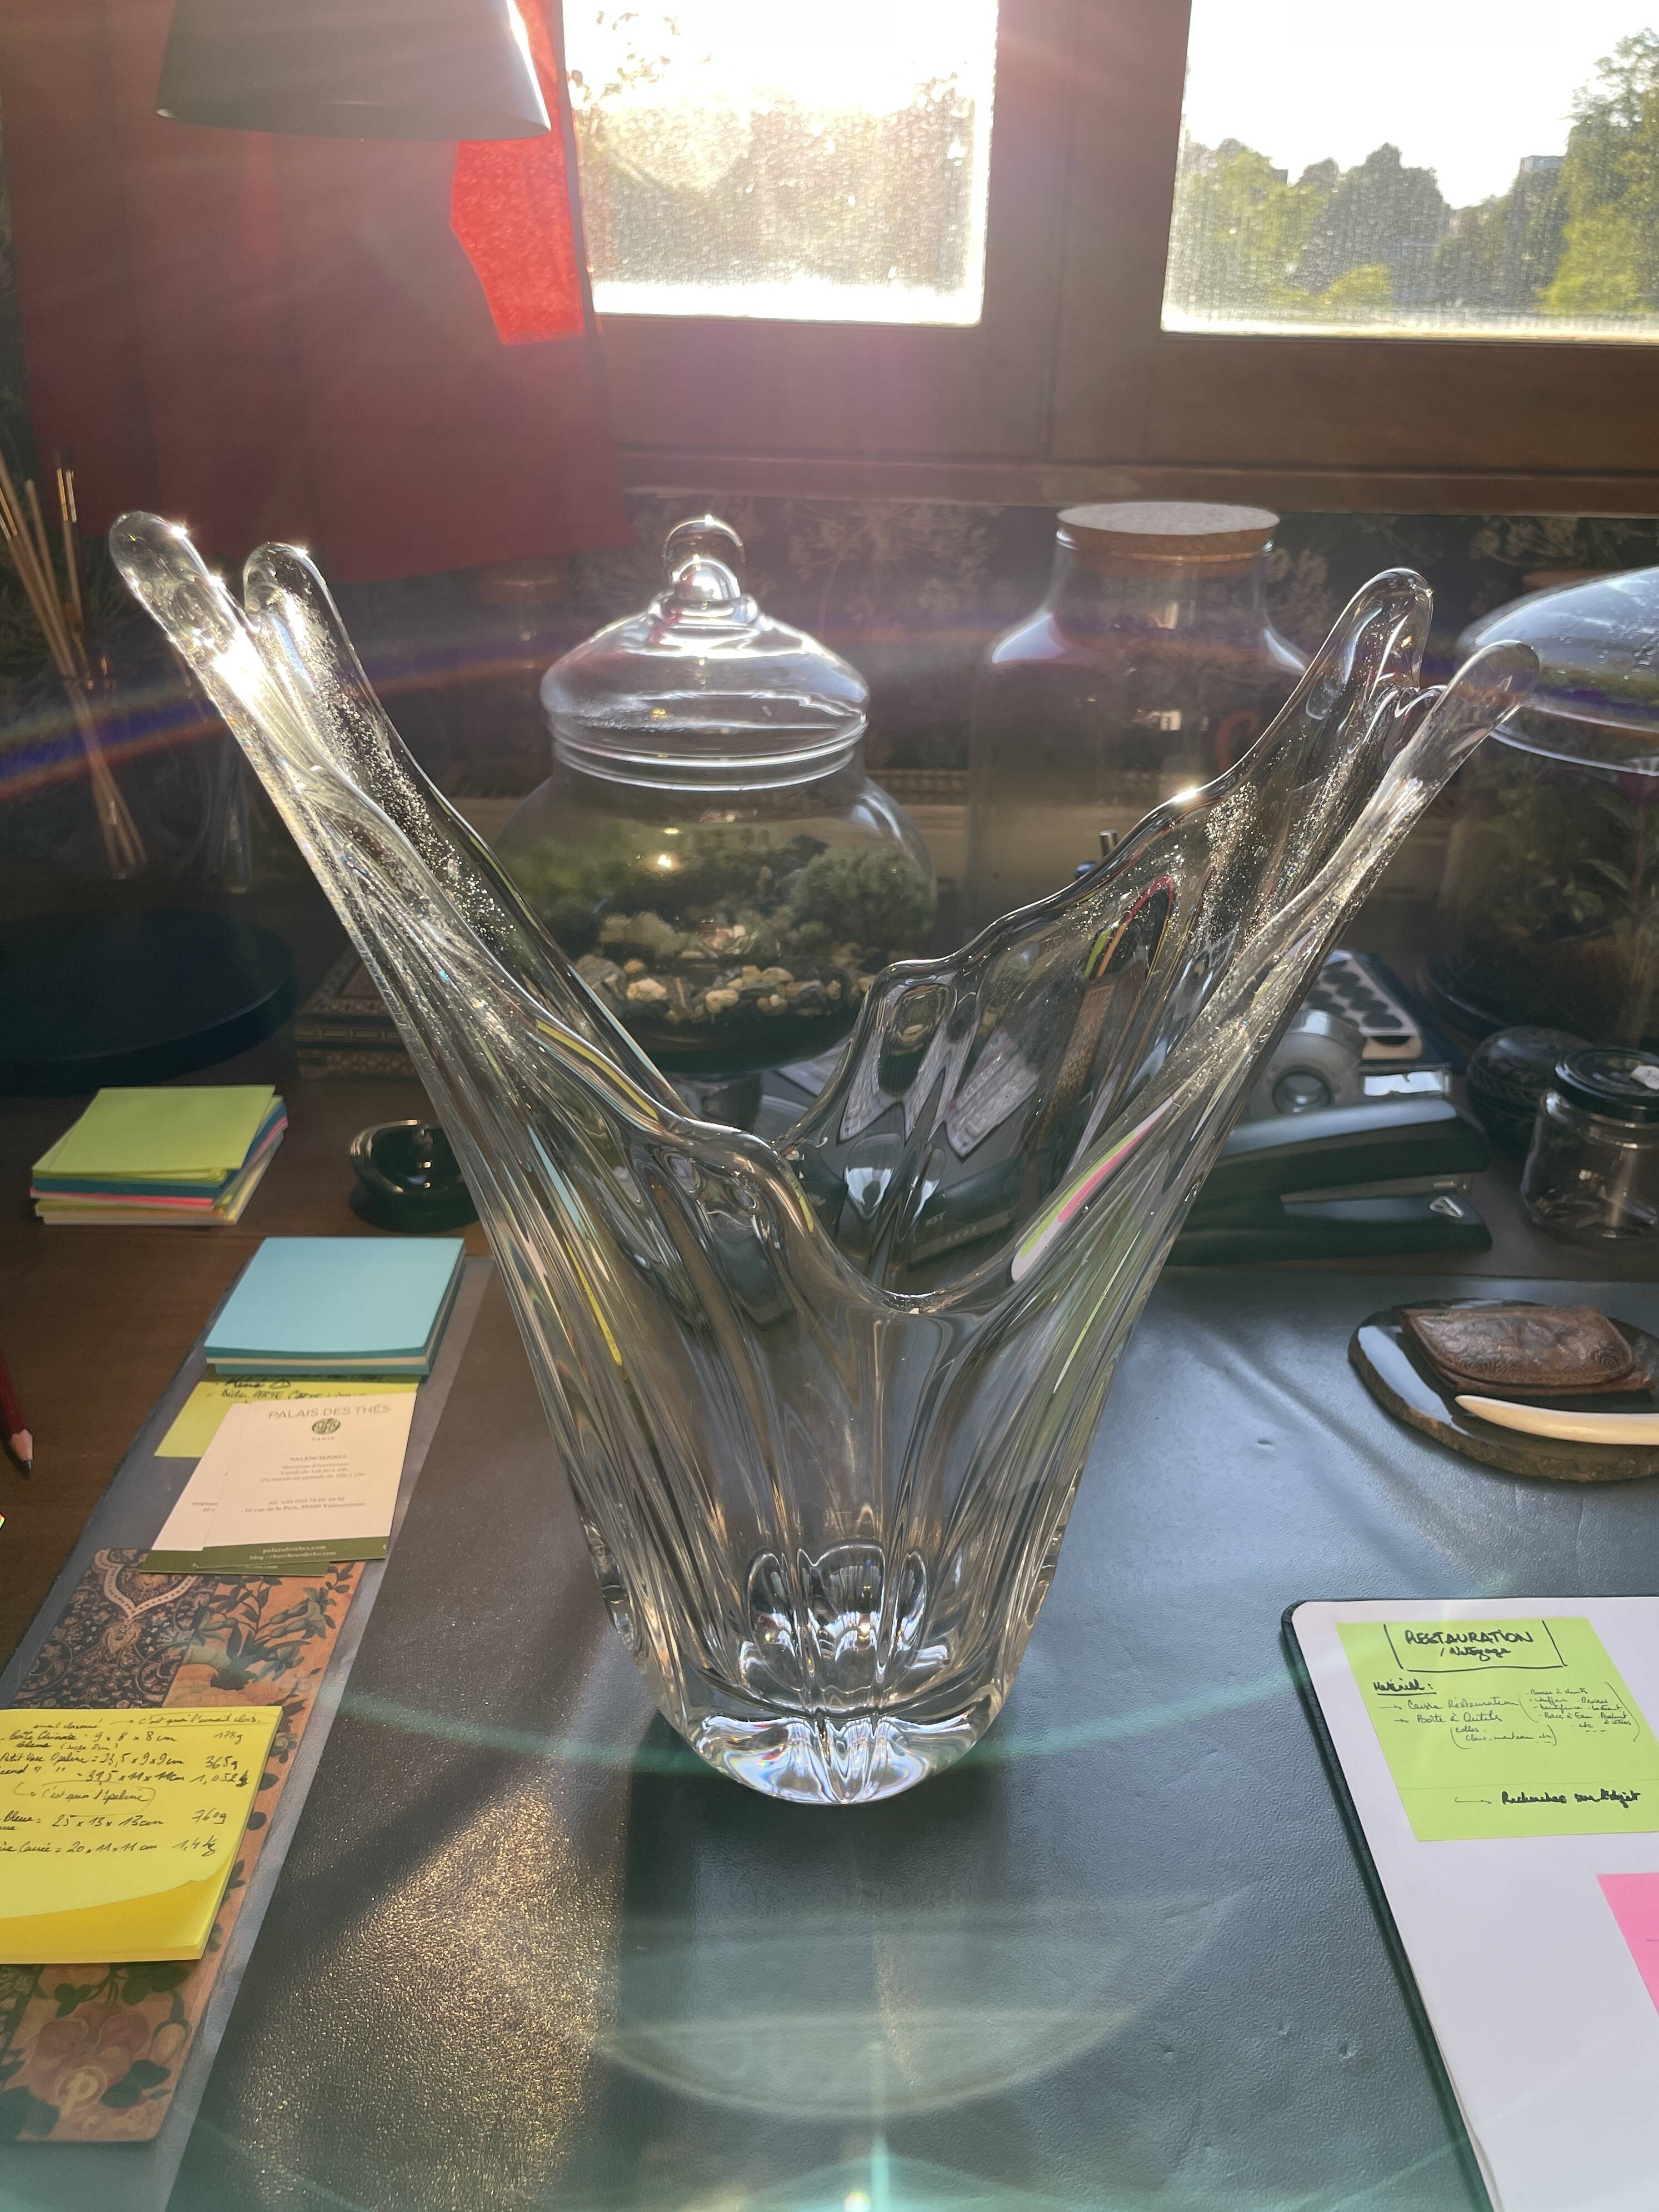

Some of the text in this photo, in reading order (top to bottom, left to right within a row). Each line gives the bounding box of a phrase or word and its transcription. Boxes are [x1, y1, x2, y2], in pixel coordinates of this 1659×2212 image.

[268, 1404, 392, 1420] PALAIS DES THÉS
